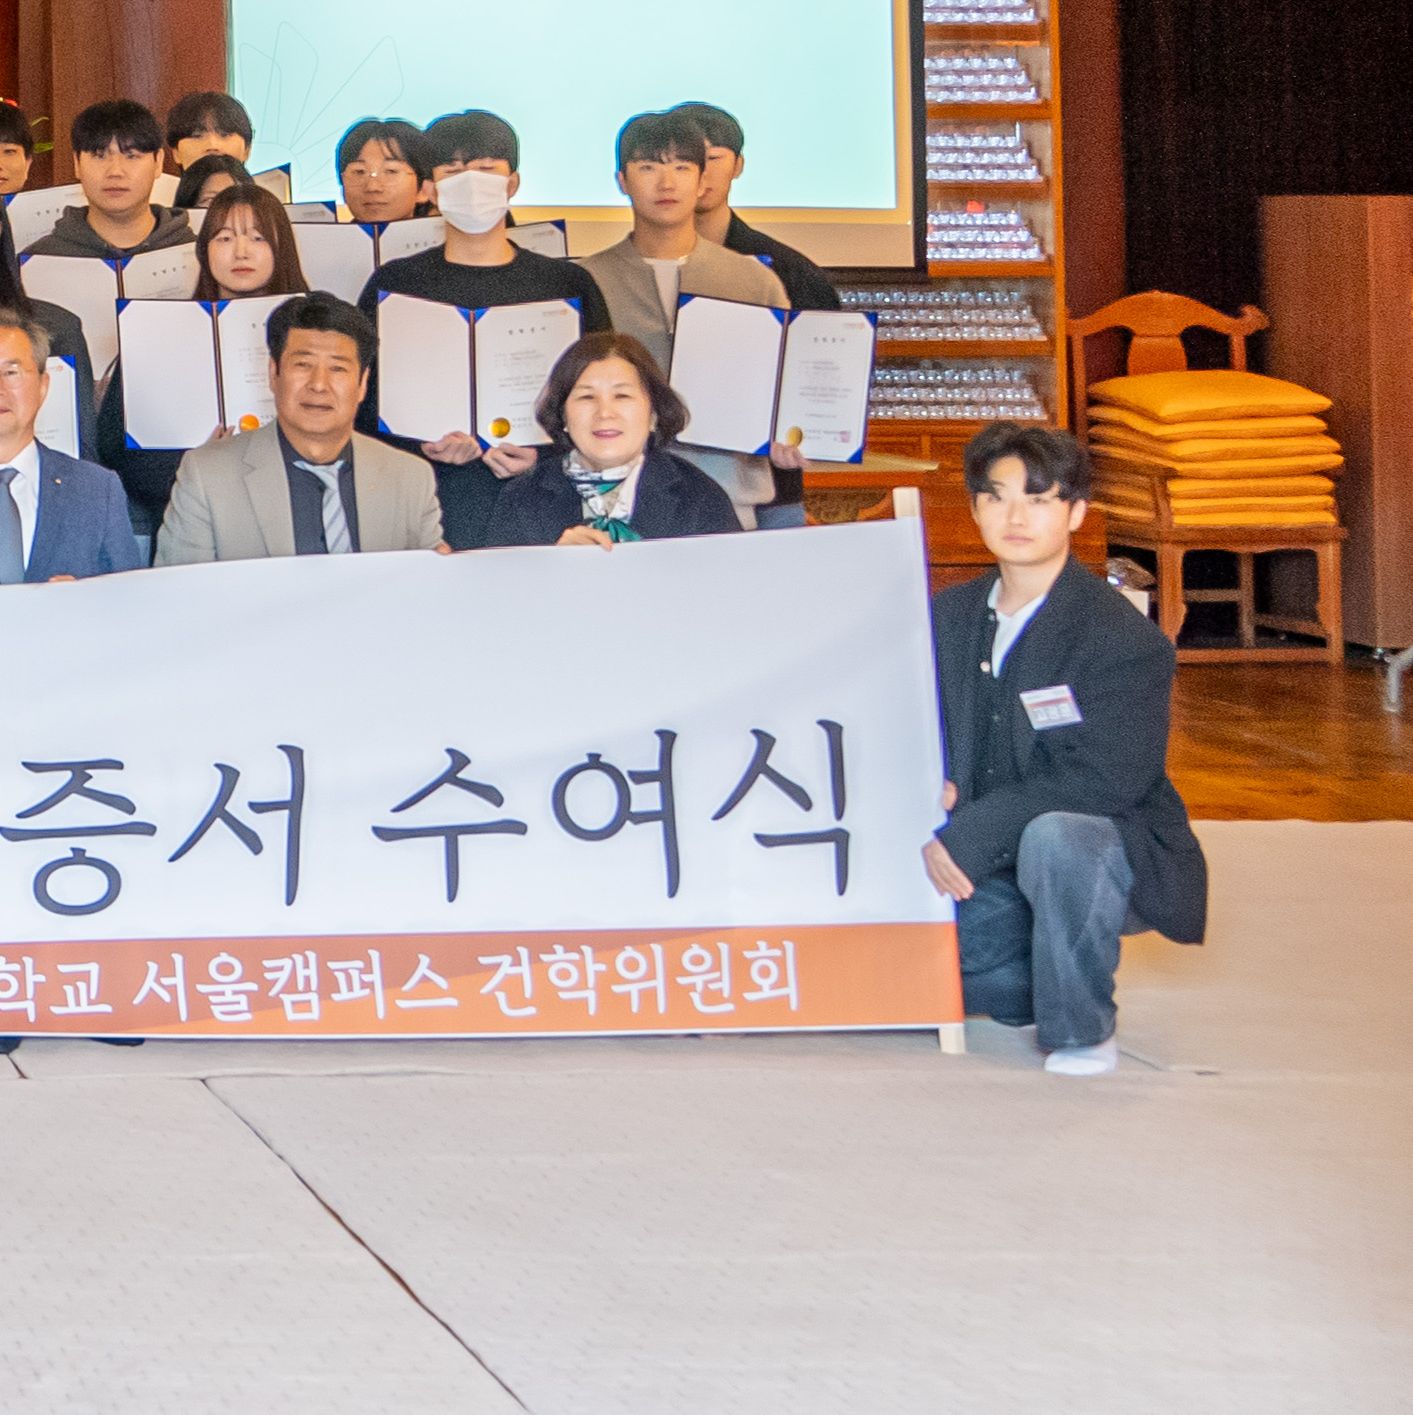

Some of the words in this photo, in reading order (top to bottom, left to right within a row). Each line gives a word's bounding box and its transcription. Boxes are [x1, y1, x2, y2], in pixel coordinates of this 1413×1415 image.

[371, 718, 852, 904] 수여식
[132, 948, 460, 1023] 서울캠퍼스
[476, 939, 799, 1018] 건학위원회
